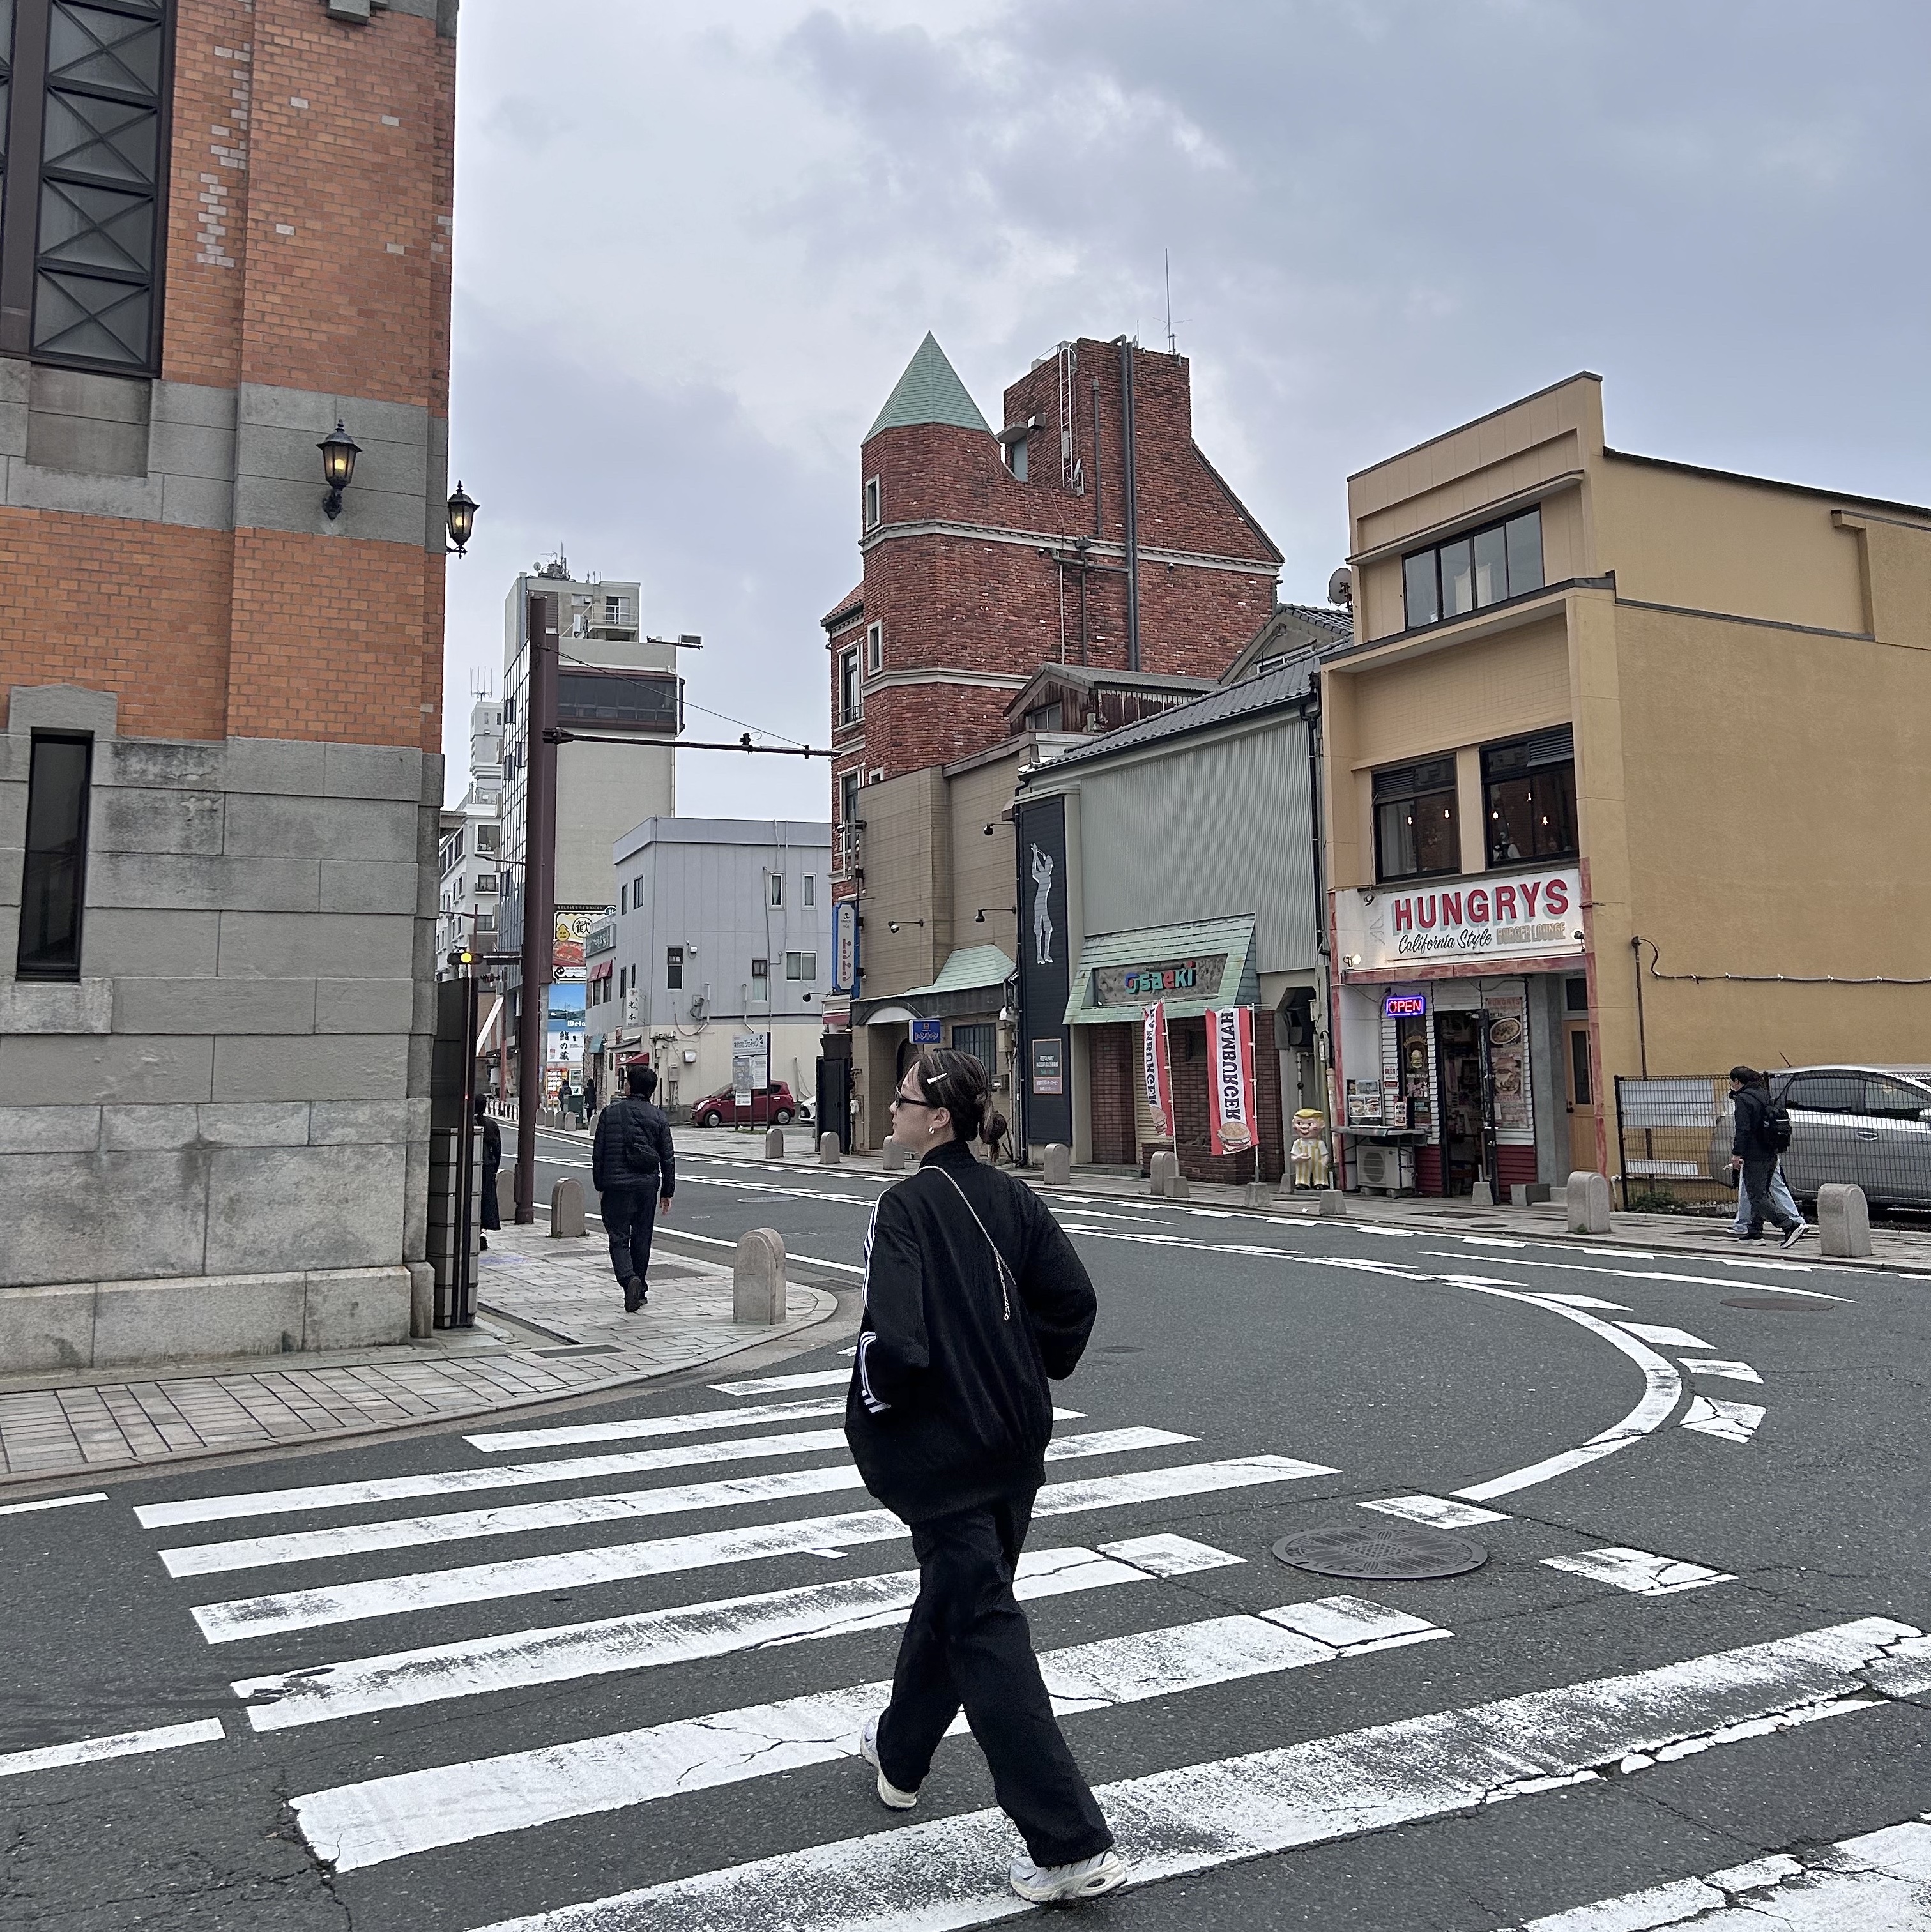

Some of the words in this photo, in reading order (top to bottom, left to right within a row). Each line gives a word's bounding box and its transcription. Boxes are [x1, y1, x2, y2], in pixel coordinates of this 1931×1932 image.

[1393, 879, 1569, 935] HUNGRYS
[1398, 933, 1454, 954] California
[1457, 928, 1492, 950] Style
[1497, 925, 1531, 945] BURGER
[1531, 922, 1566, 942] LOUNGE
[843, 938, 851, 982] トントン
[1389, 1000, 1421, 1014] OPEN
